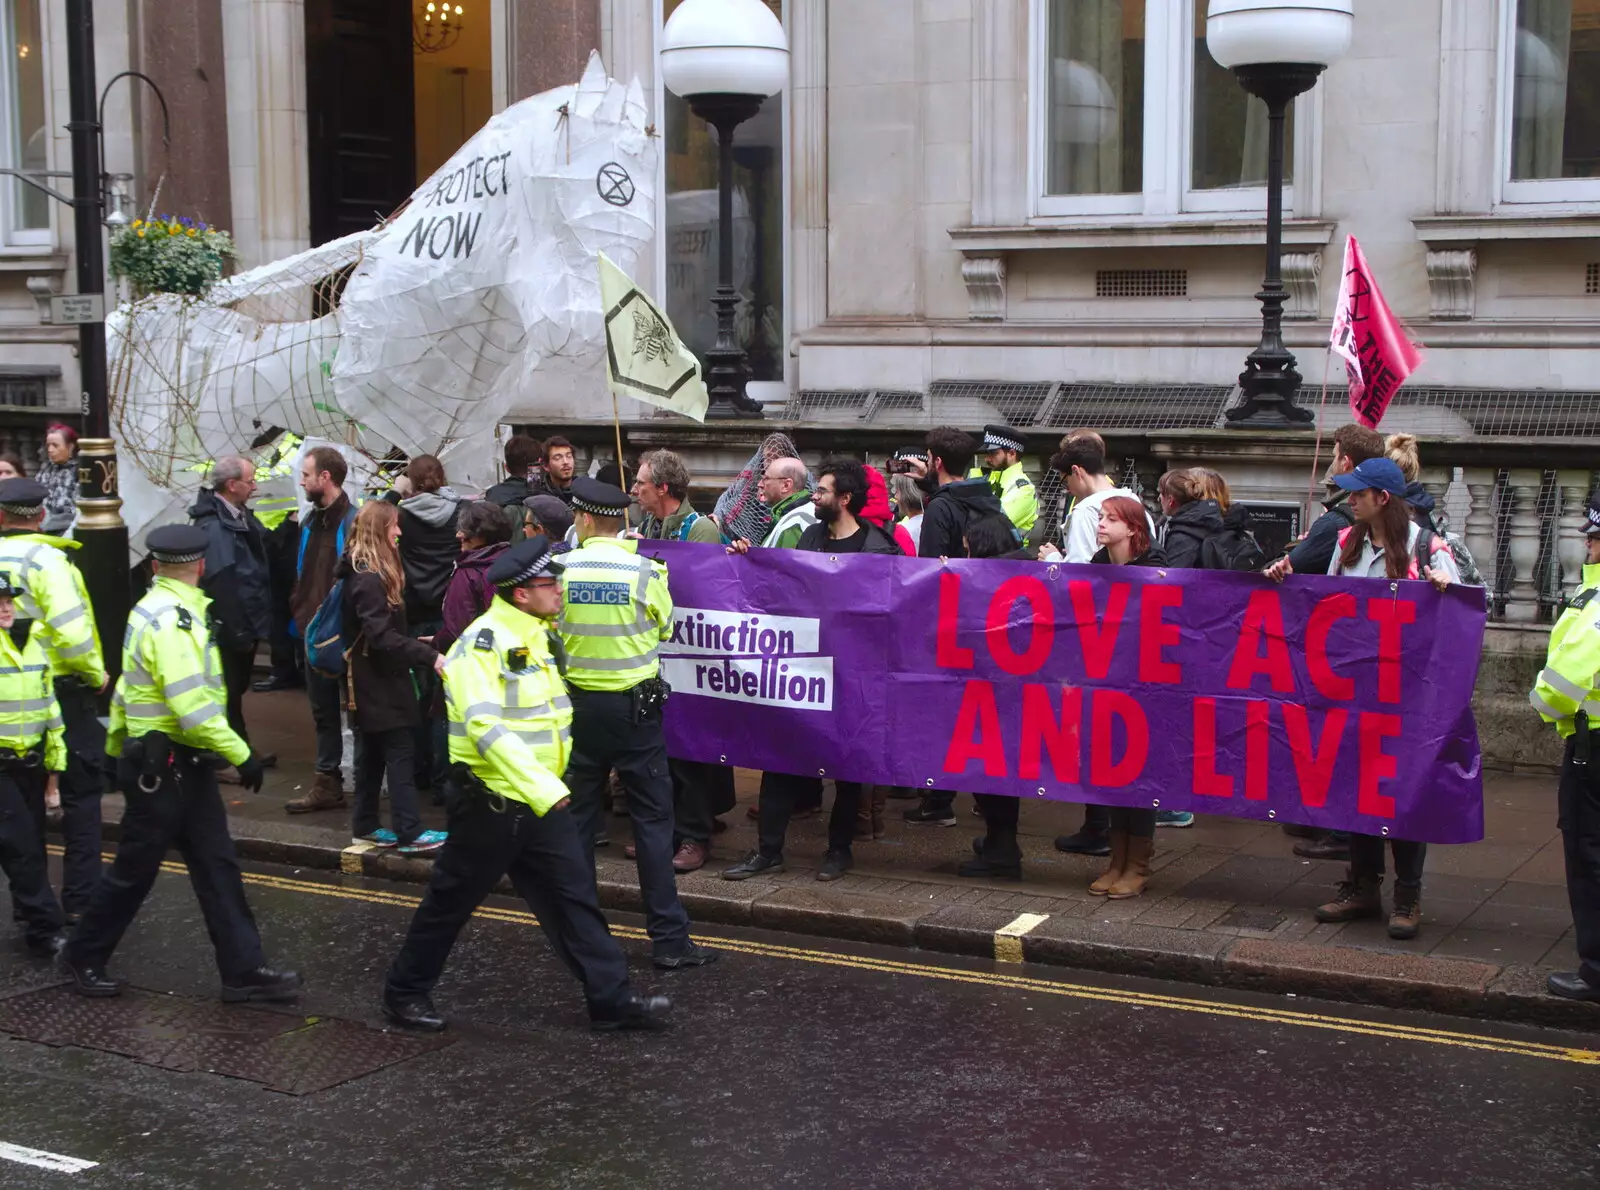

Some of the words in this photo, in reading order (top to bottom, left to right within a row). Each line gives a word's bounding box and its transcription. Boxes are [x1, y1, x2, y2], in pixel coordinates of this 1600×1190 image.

[425, 150, 511, 208] ROTECT
[398, 212, 482, 260] NOW
[568, 582, 630, 591] METROPOLITAN
[568, 590, 629, 604] POLICE
[660, 612, 794, 655] xtinction
[936, 572, 1184, 685] LOVE
[1226, 589, 1417, 704] ACT
[696, 656, 826, 704] rebellion
[943, 680, 1150, 788] AND
[1192, 696, 1402, 819] LIVE
